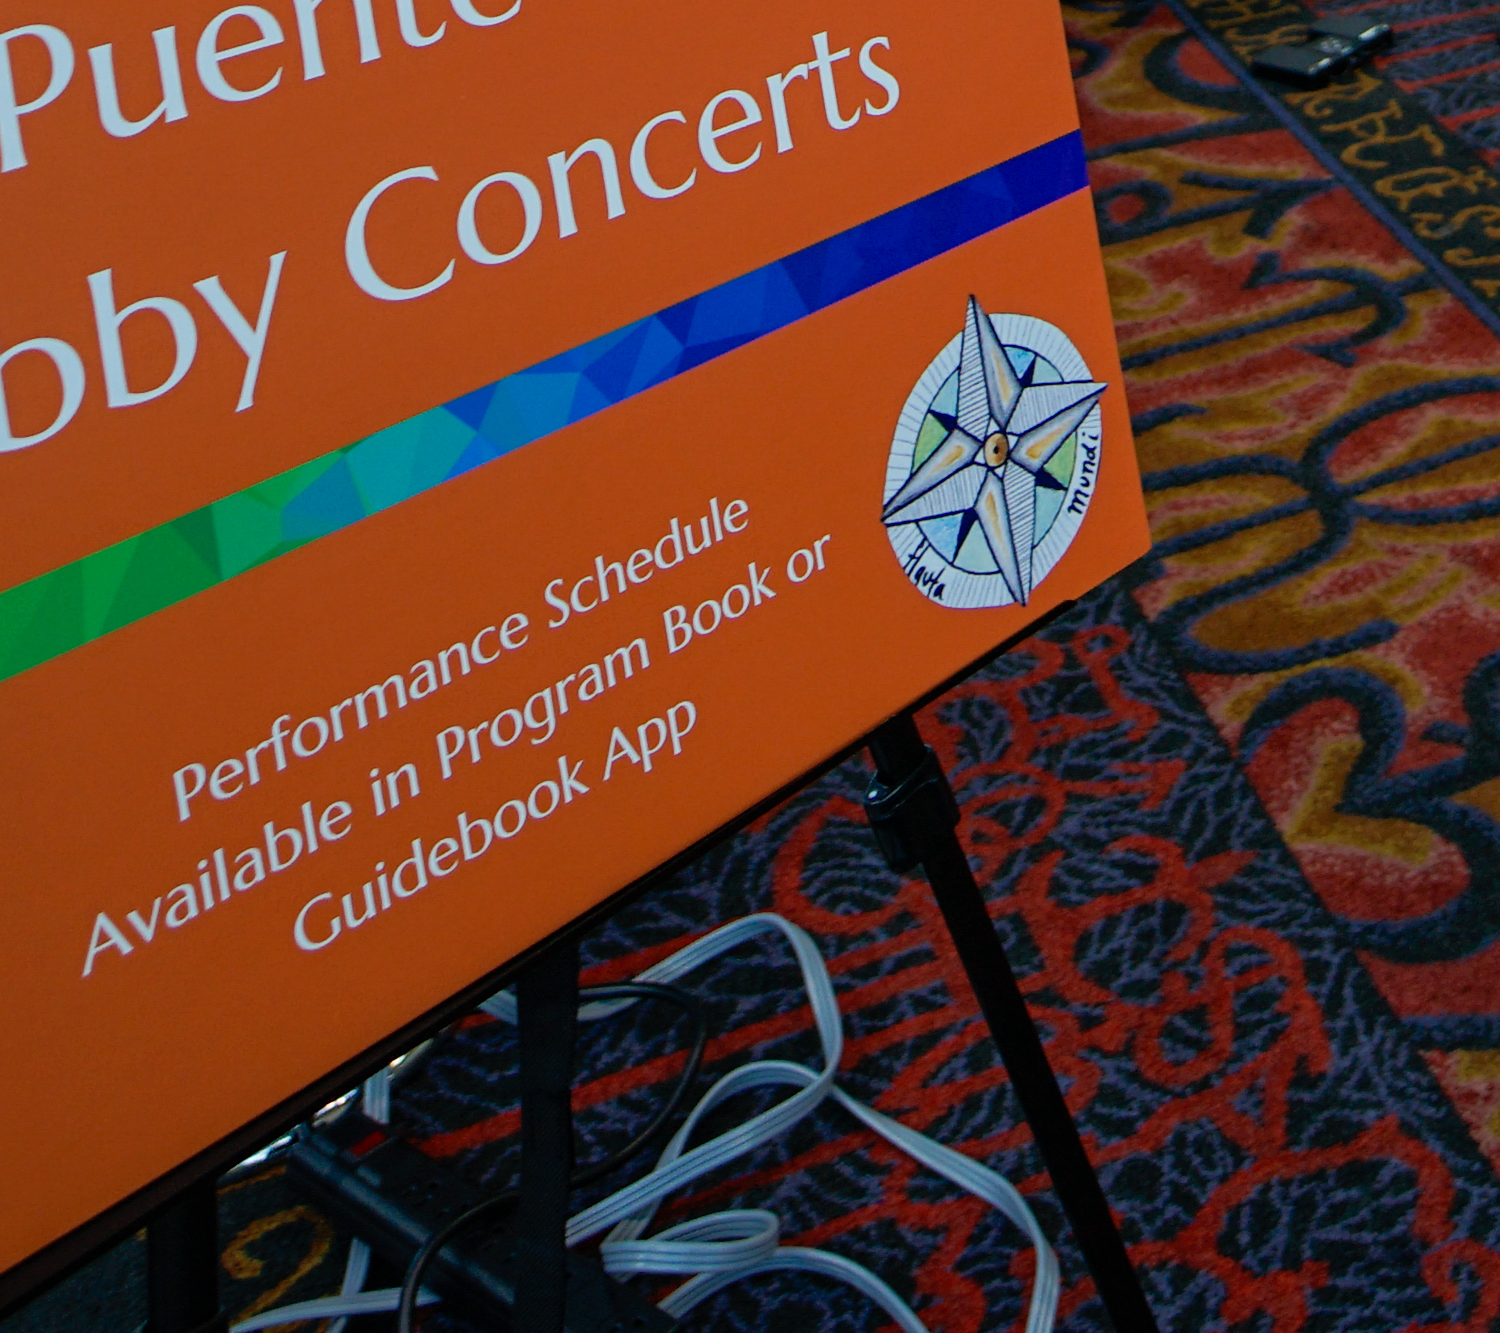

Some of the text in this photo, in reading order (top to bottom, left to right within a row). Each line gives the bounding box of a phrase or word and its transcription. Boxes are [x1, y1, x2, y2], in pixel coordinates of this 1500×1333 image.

[345, 32, 900, 300] Concerts
[83, 535, 831, 977] Available in Program Book or
[174, 498, 748, 821] Performance Schedule
[292, 701, 696, 951] Guidebook App
